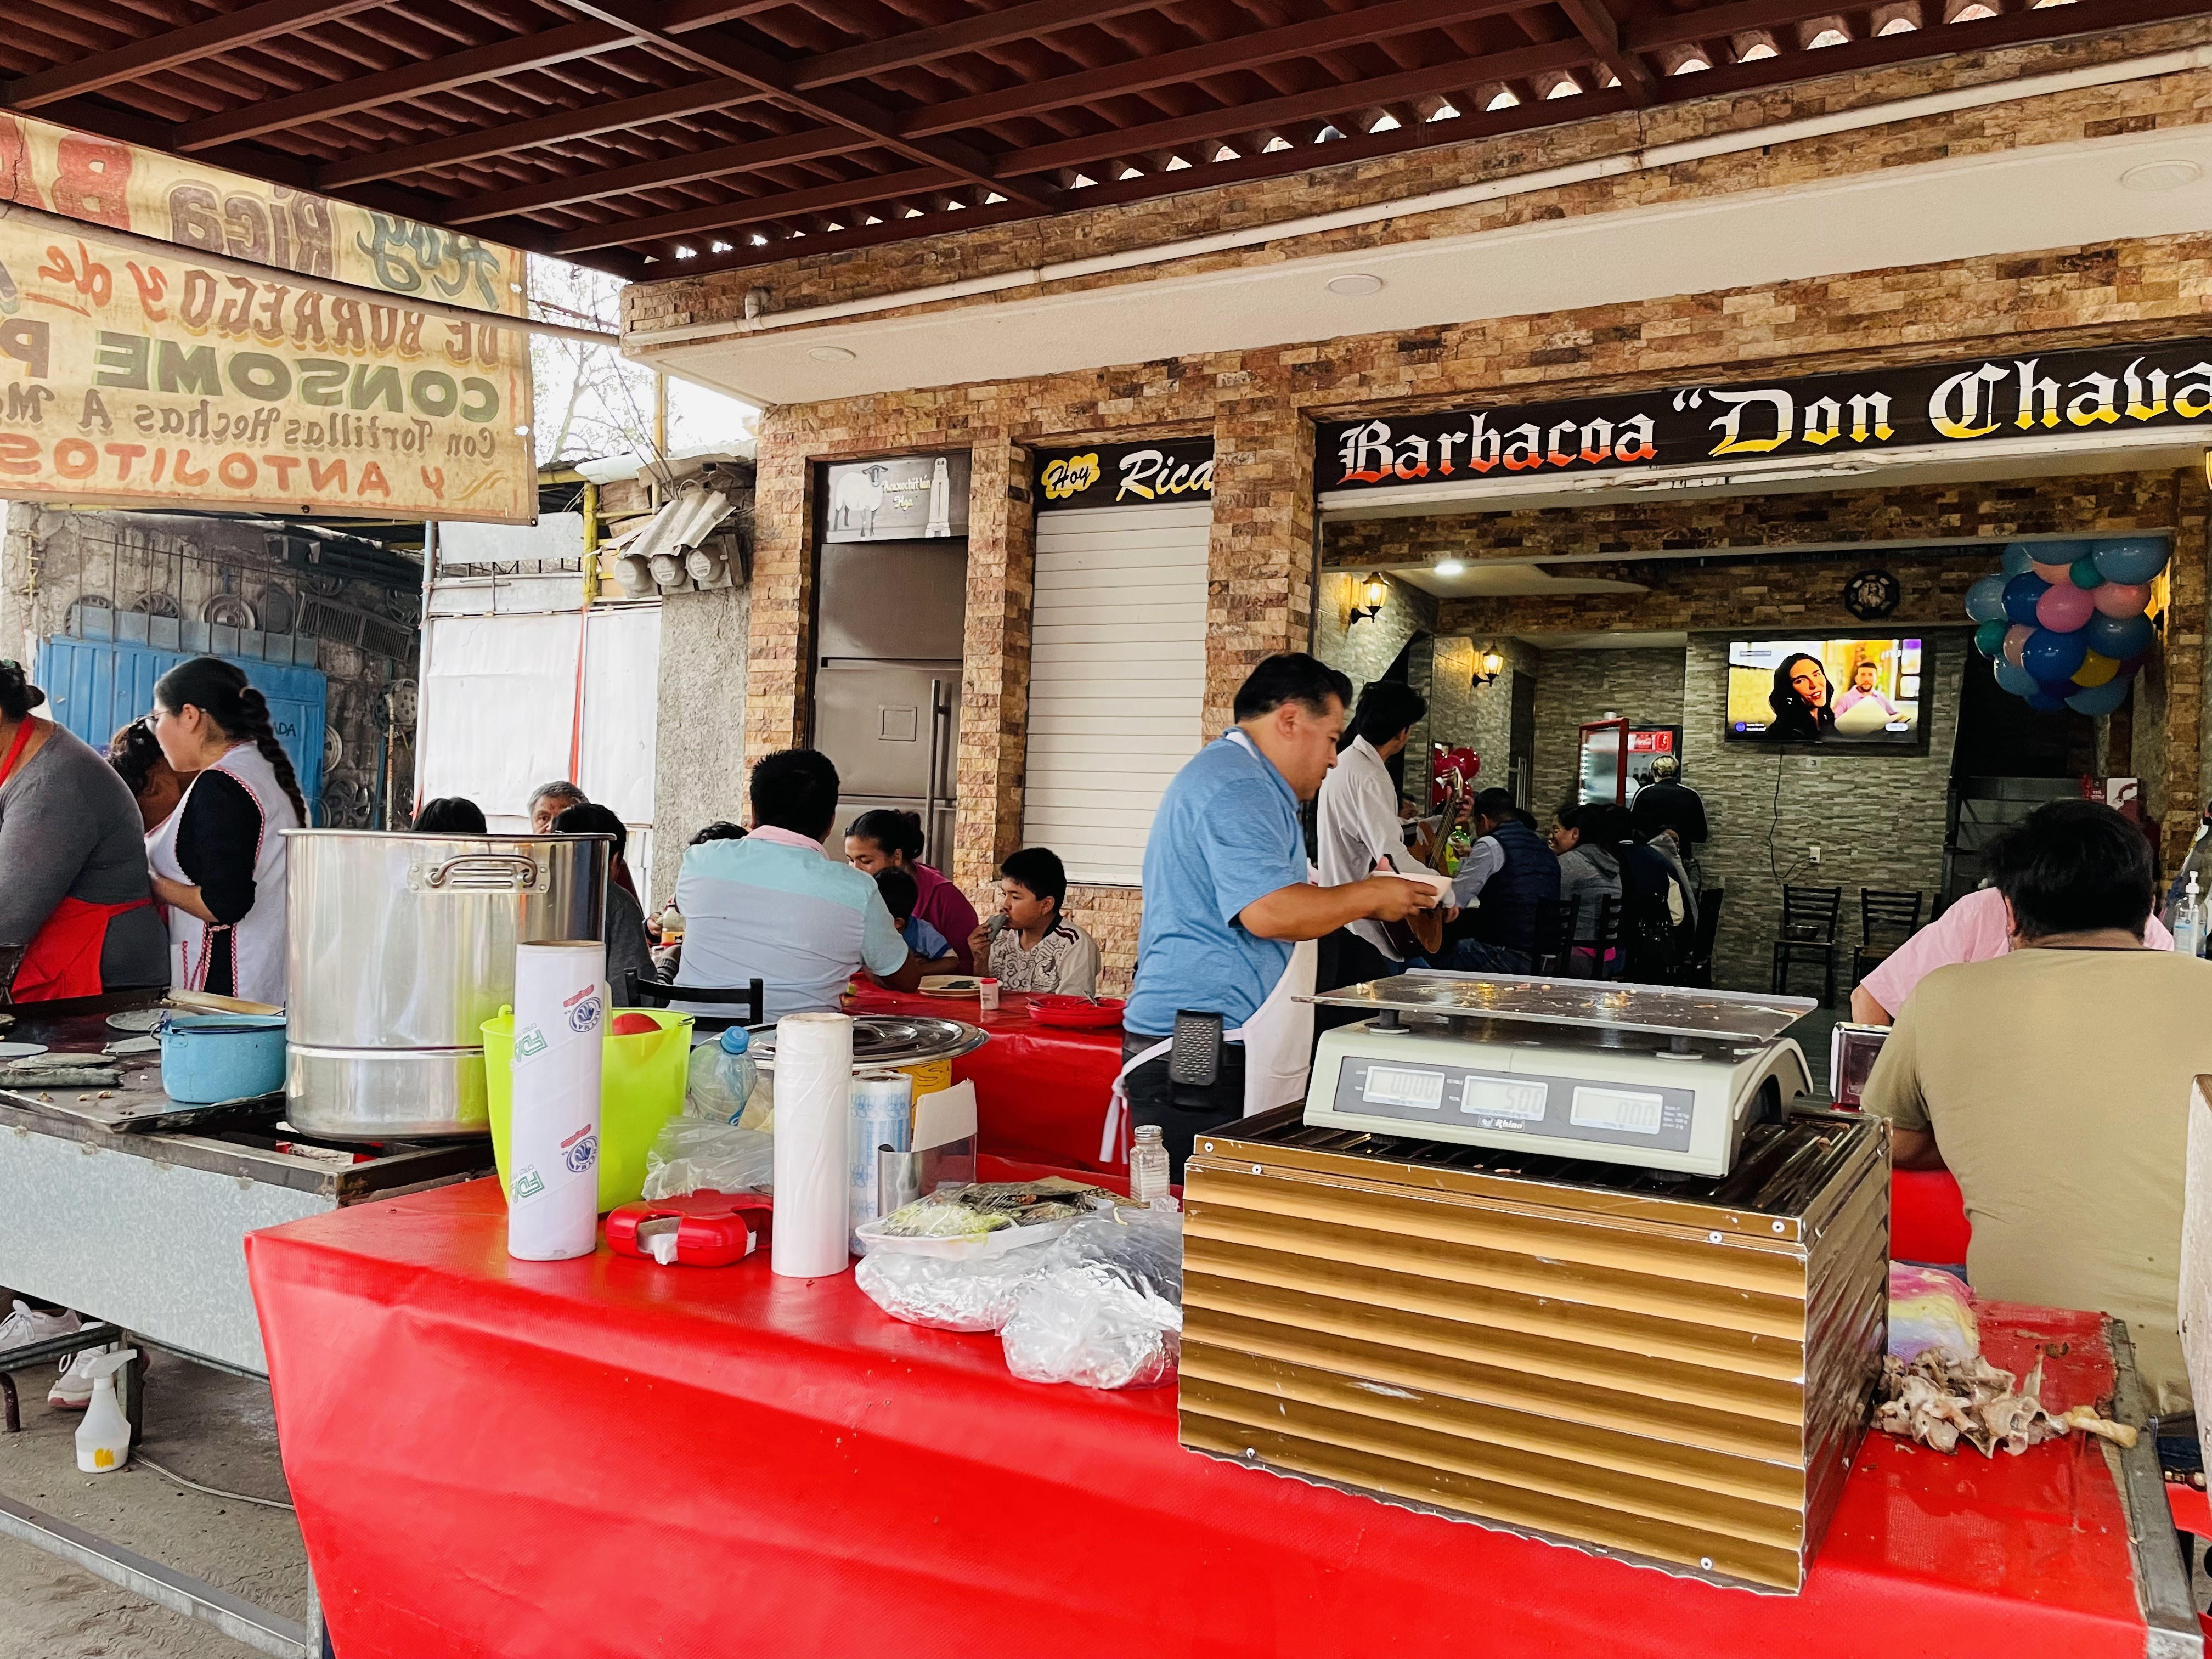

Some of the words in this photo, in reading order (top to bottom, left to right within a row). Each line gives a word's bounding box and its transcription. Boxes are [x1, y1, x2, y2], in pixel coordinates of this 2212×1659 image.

[1336, 411, 1658, 485] Barbacoa
[1047, 464, 1091, 492] Hoy
[1115, 450, 1214, 501] Rica
[1495, 1119, 1523, 1129] Rhino
